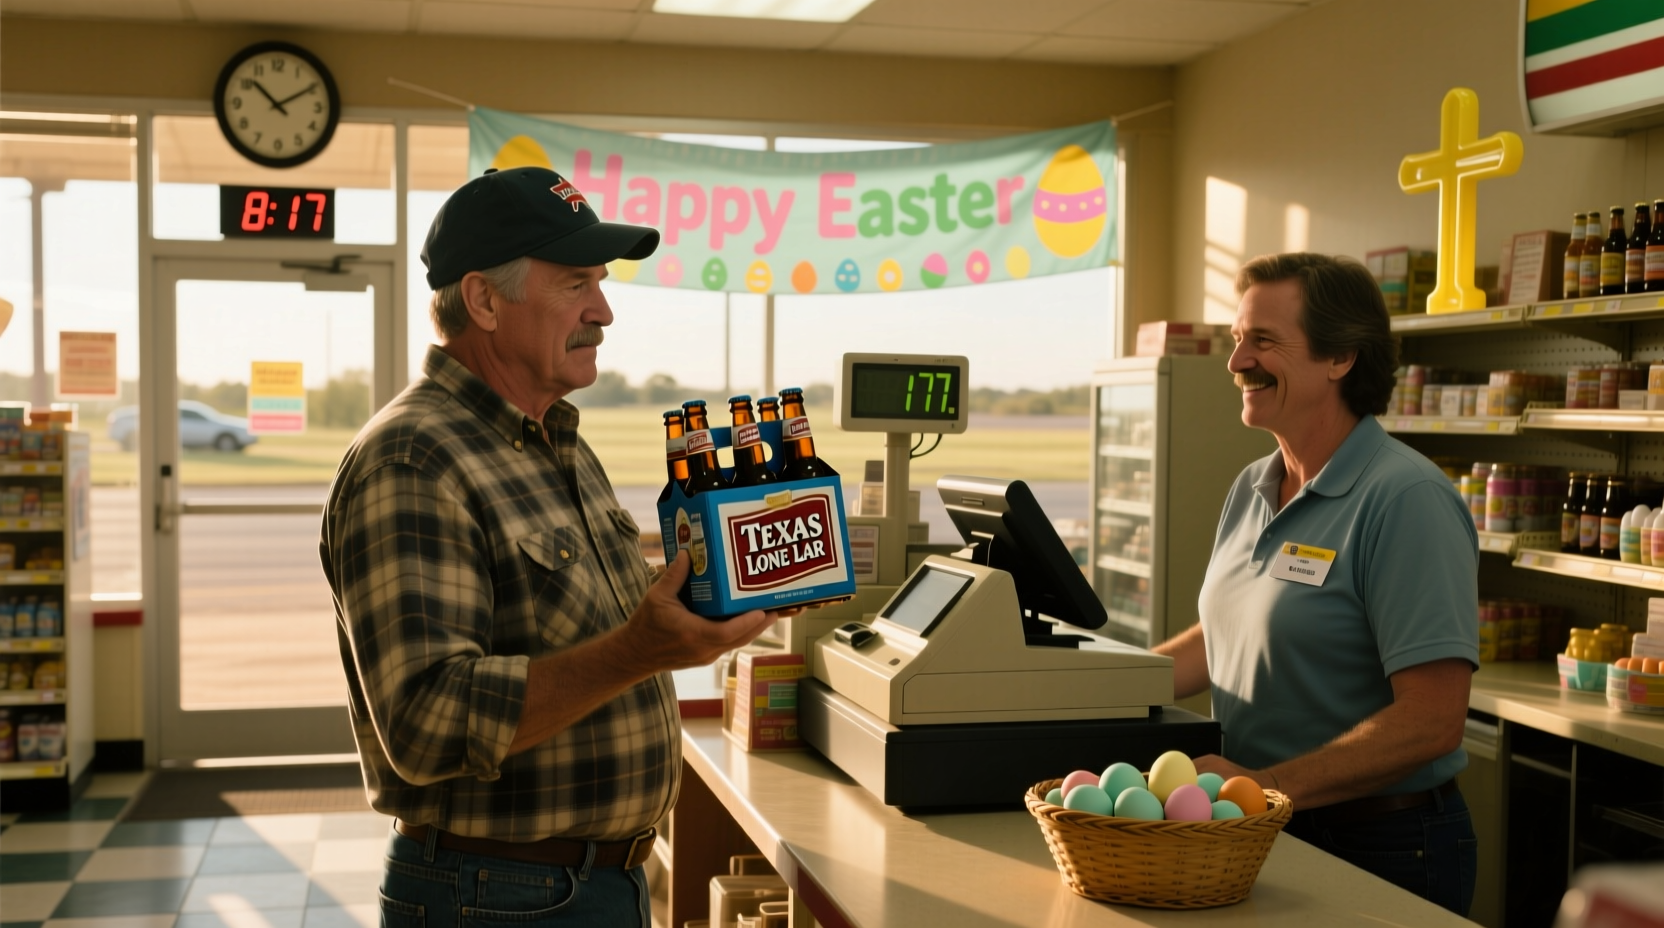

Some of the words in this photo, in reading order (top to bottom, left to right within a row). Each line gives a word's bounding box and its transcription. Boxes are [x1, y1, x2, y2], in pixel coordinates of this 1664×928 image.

[271, 58, 285, 72] 12
[232, 96, 243, 110] 9
[254, 131, 262, 144] 7
[241, 191, 327, 231] 8:17
[573, 148, 795, 255] Happy
[818, 172, 1025, 239] Easter
[740, 513, 823, 553] TEXAS
[745, 548, 790, 576] LONE
[792, 540, 826, 563] LAR
